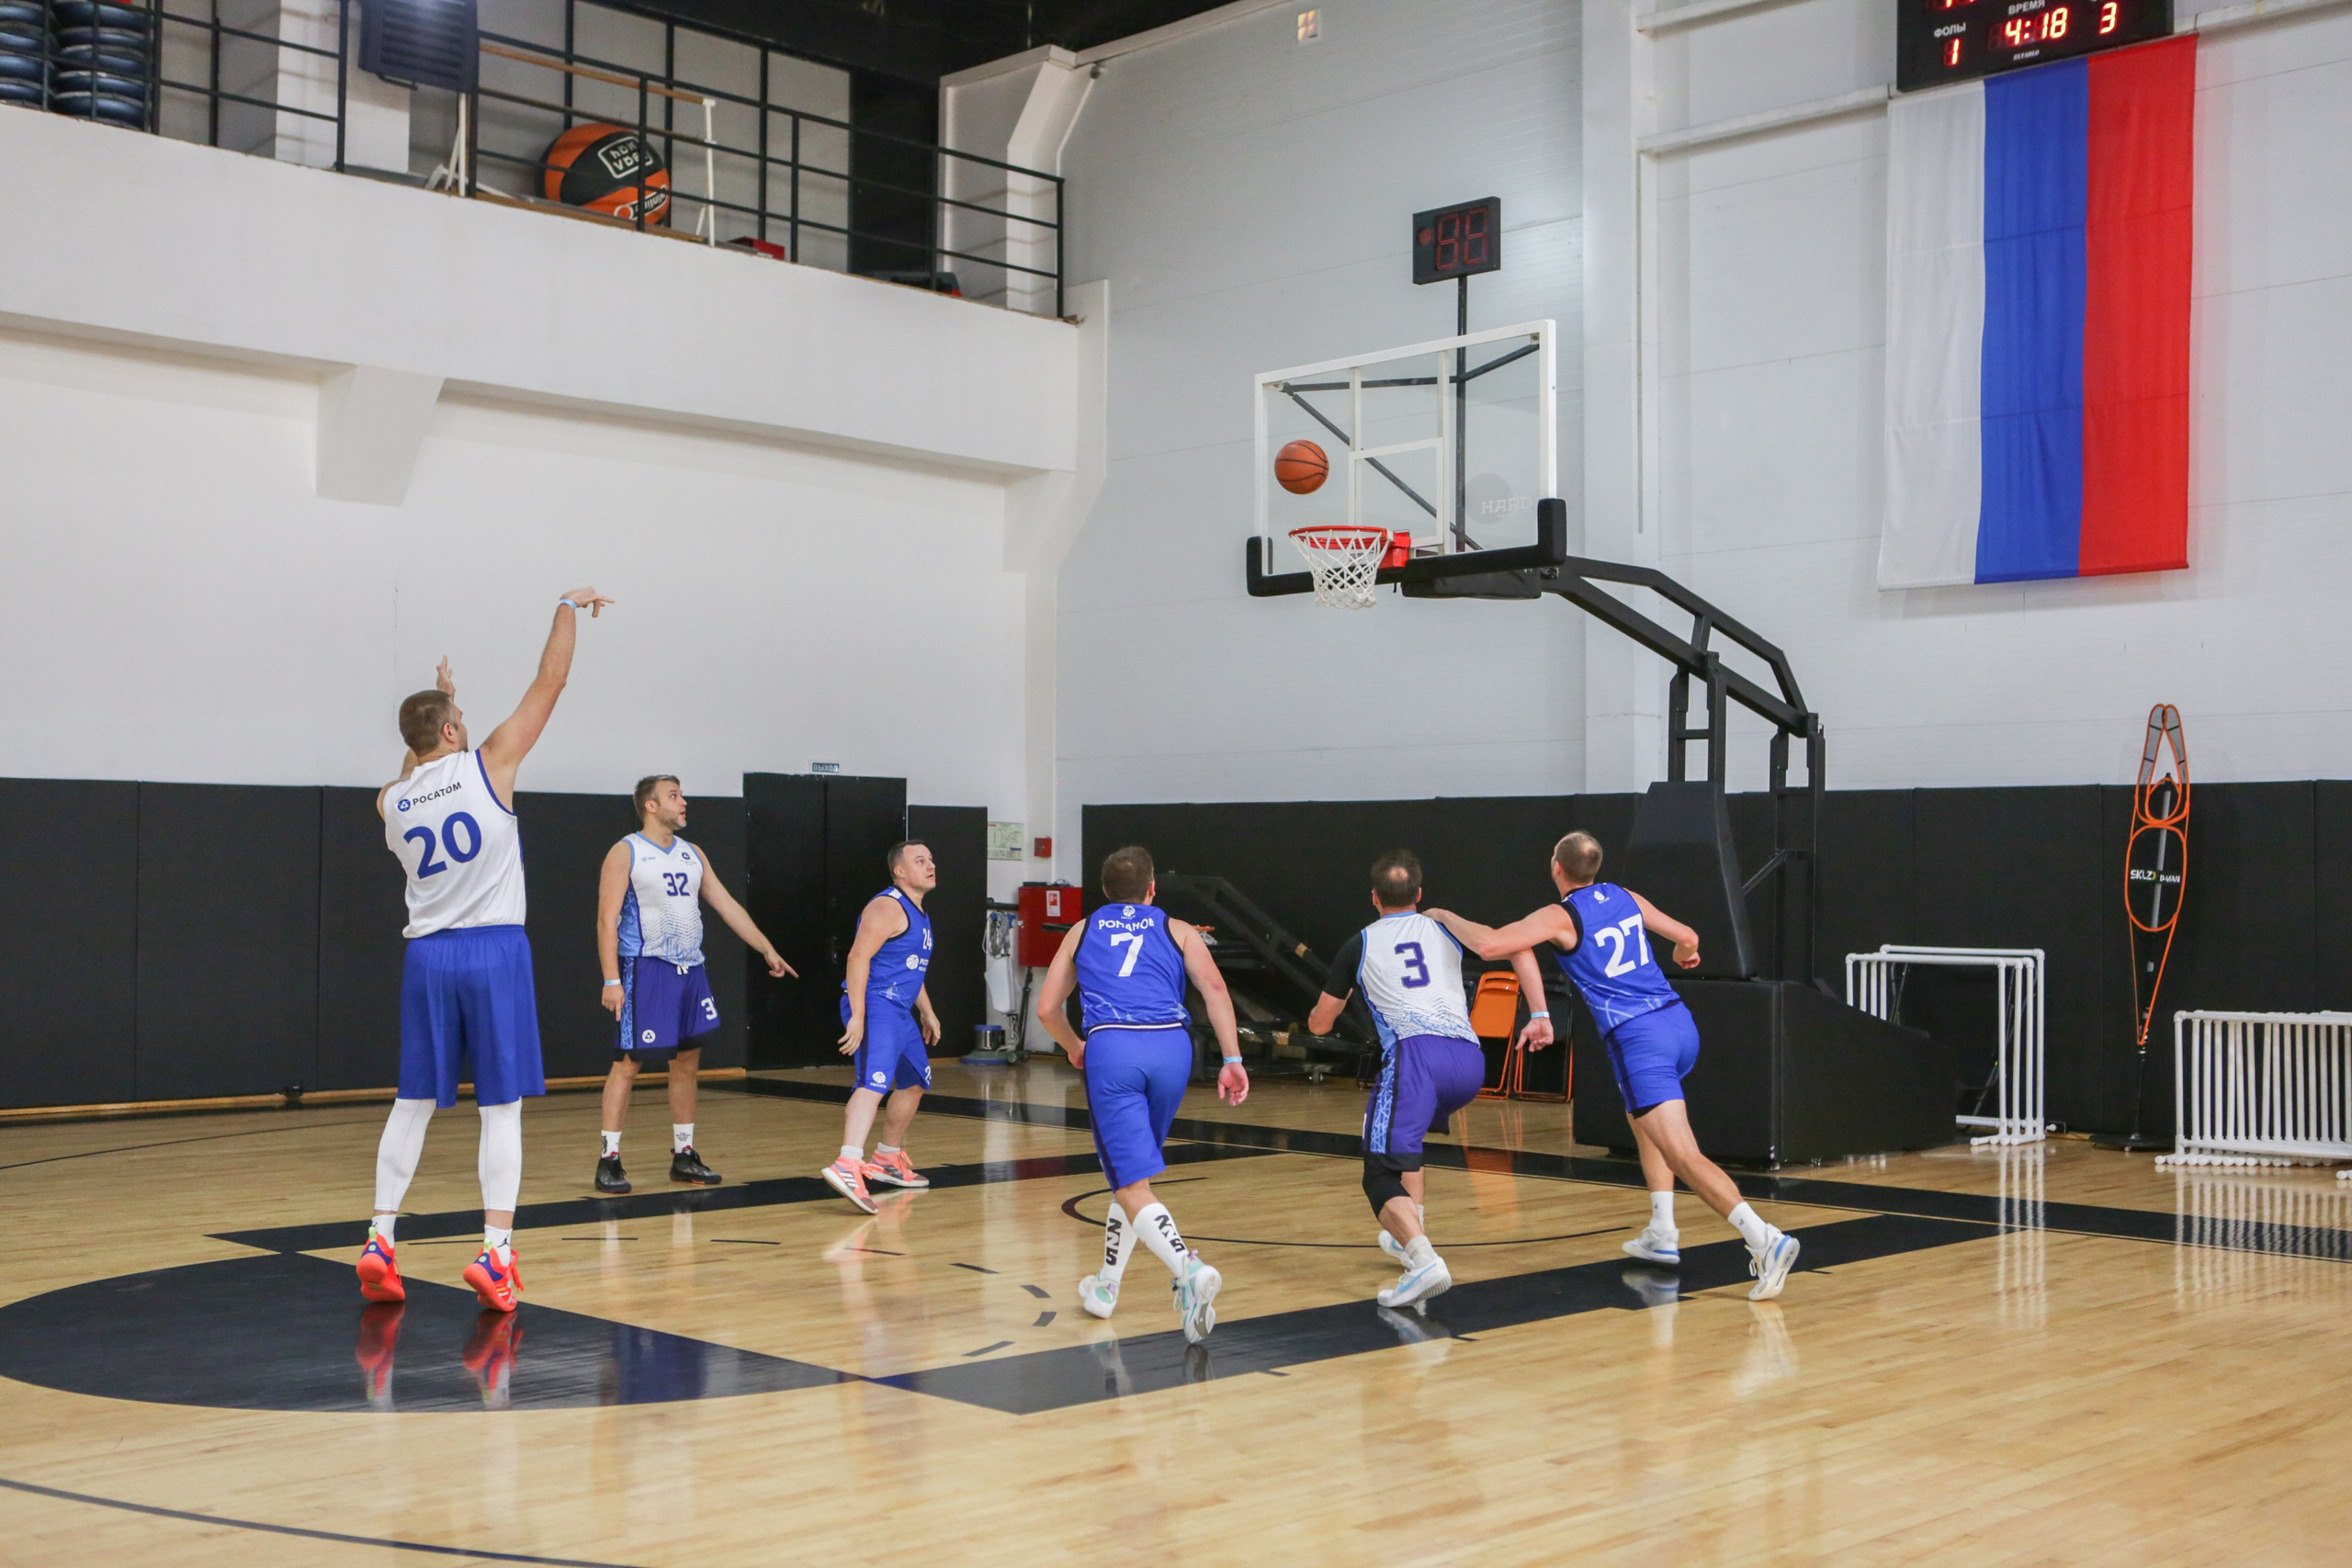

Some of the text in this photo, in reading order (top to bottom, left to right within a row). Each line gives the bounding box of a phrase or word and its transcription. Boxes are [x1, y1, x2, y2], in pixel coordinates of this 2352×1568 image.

[2008, 0, 2045, 15] ВРЕМЯ
[2099, 2, 2118, 34] 3
[1934, 22, 1966, 38] ФОЛЫ
[2006, 7, 2068, 45] 4:18
[1951, 38, 1960, 64] 1
[1481, 496, 1533, 514] HARD
[813, 763, 839, 773] ВЫХОД
[413, 782, 462, 806] РОСАТОМ
[403, 811, 481, 879] 20
[662, 872, 690, 897] 32
[2131, 869, 2153, 881] SKLZ
[922, 928, 933, 951] 24
[1594, 913, 1649, 978] 27
[1110, 932, 1144, 977] 7
[1394, 942, 1430, 989] 3
[701, 996, 718, 1021] 3
[924, 1066, 932, 1085] 2
